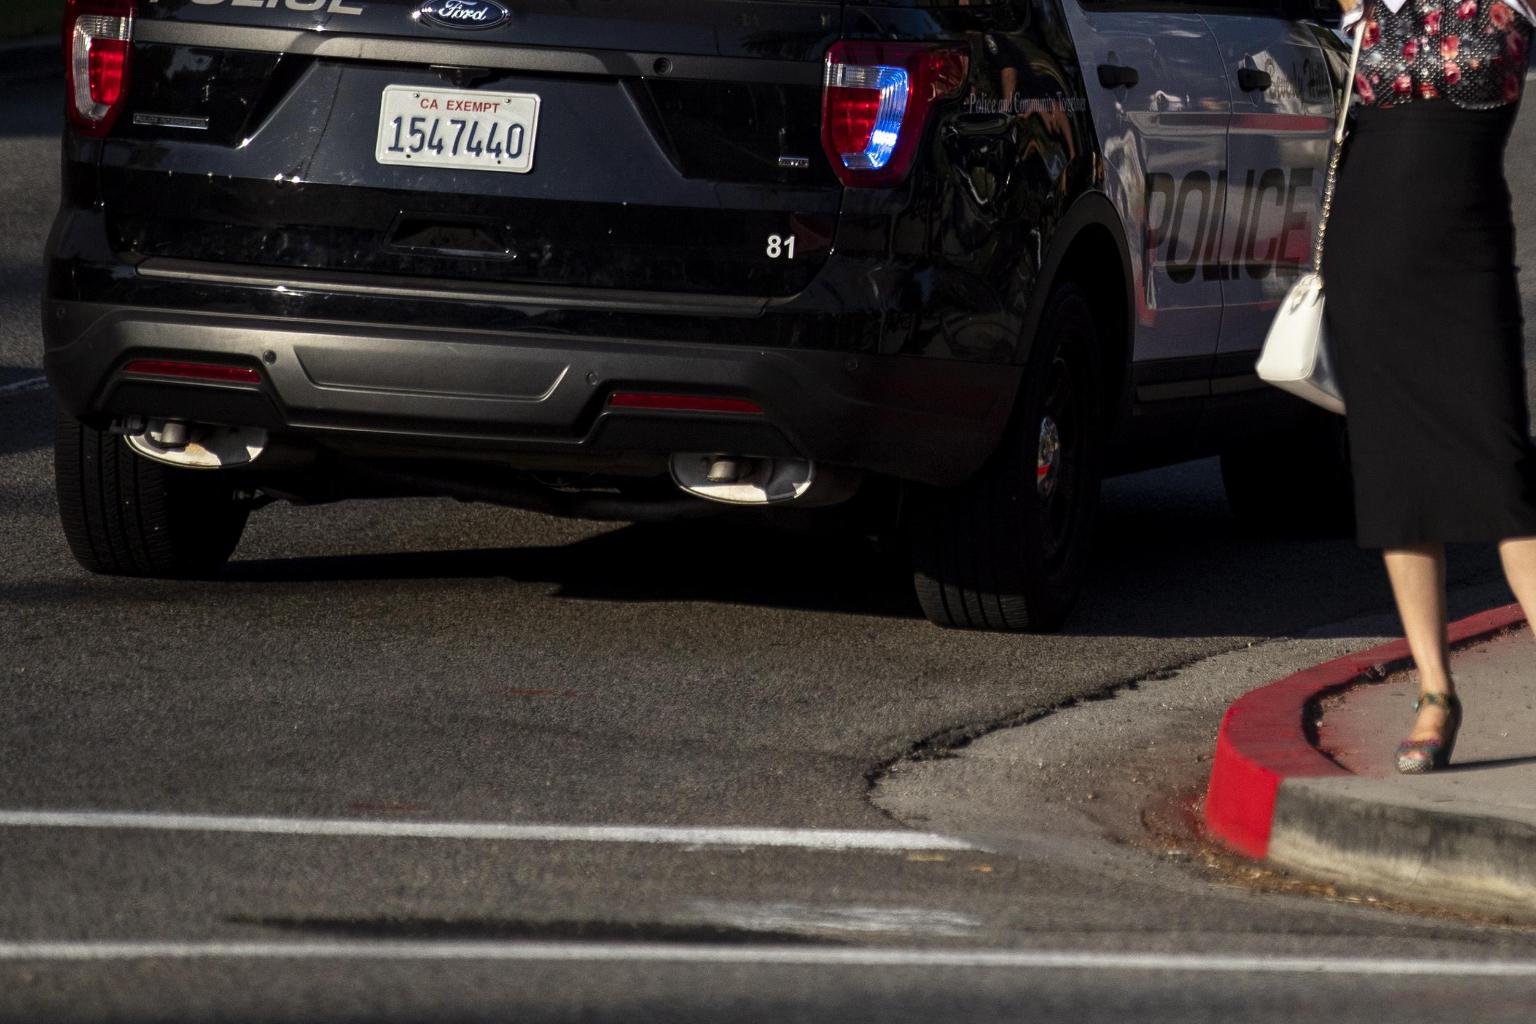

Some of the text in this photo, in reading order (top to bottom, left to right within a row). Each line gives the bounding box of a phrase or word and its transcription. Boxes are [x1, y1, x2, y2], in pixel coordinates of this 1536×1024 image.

[438, 0, 489, 21] Ford
[420, 98, 501, 114] CA EXEMPT
[969, 91, 997, 114] Police
[387, 116, 525, 159] 1547440
[1144, 168, 1314, 284] POLICE
[766, 234, 796, 259] 81
